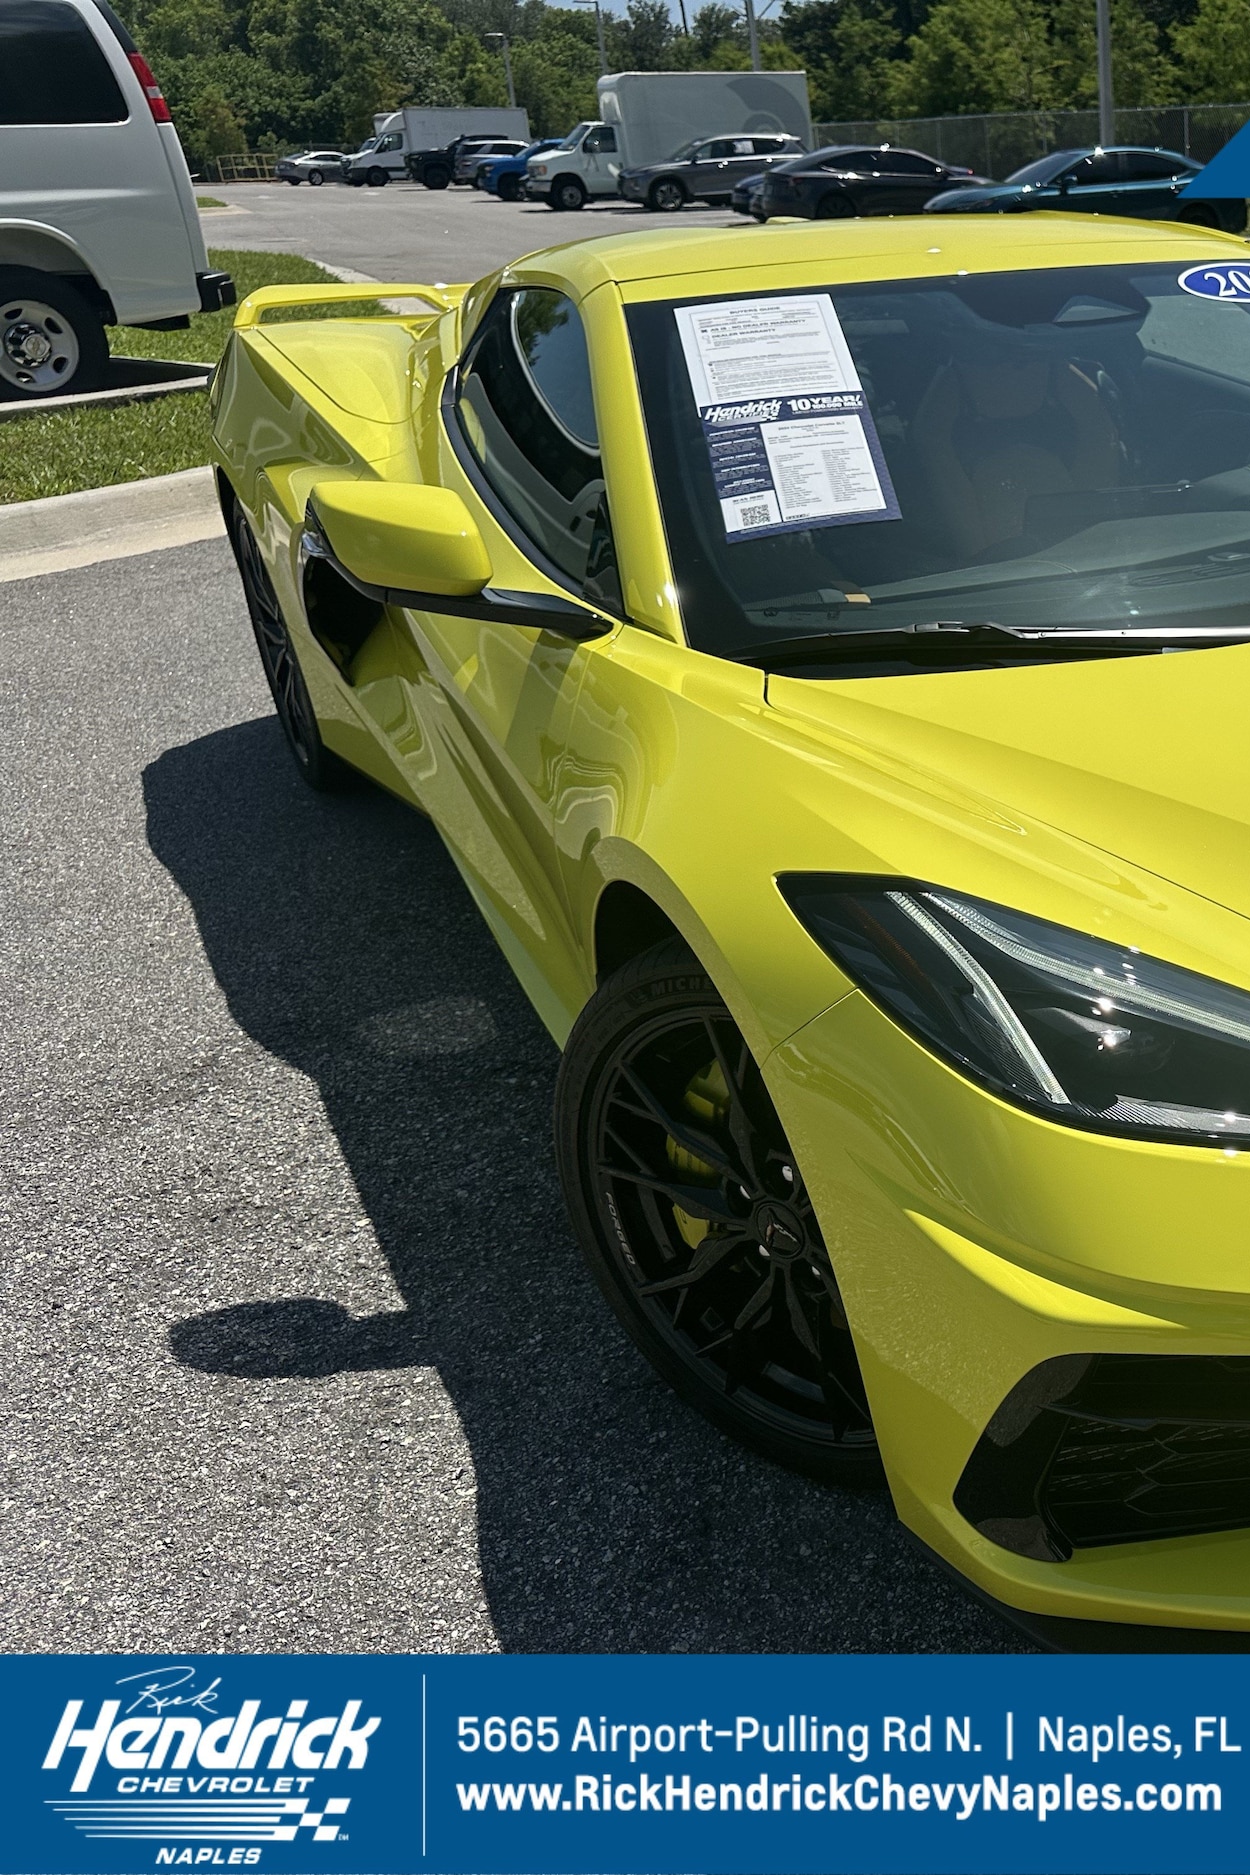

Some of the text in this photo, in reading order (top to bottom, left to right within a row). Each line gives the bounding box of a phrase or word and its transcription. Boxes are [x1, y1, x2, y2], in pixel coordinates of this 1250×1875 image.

[739, 328, 776, 336] WARRANTY
[743, 321, 769, 329] DEALER
[704, 399, 783, 423] Hendrick
[787, 398, 812, 412] 10
[649, 976, 716, 998] MICHE
[605, 1191, 637, 1265] FORGED
